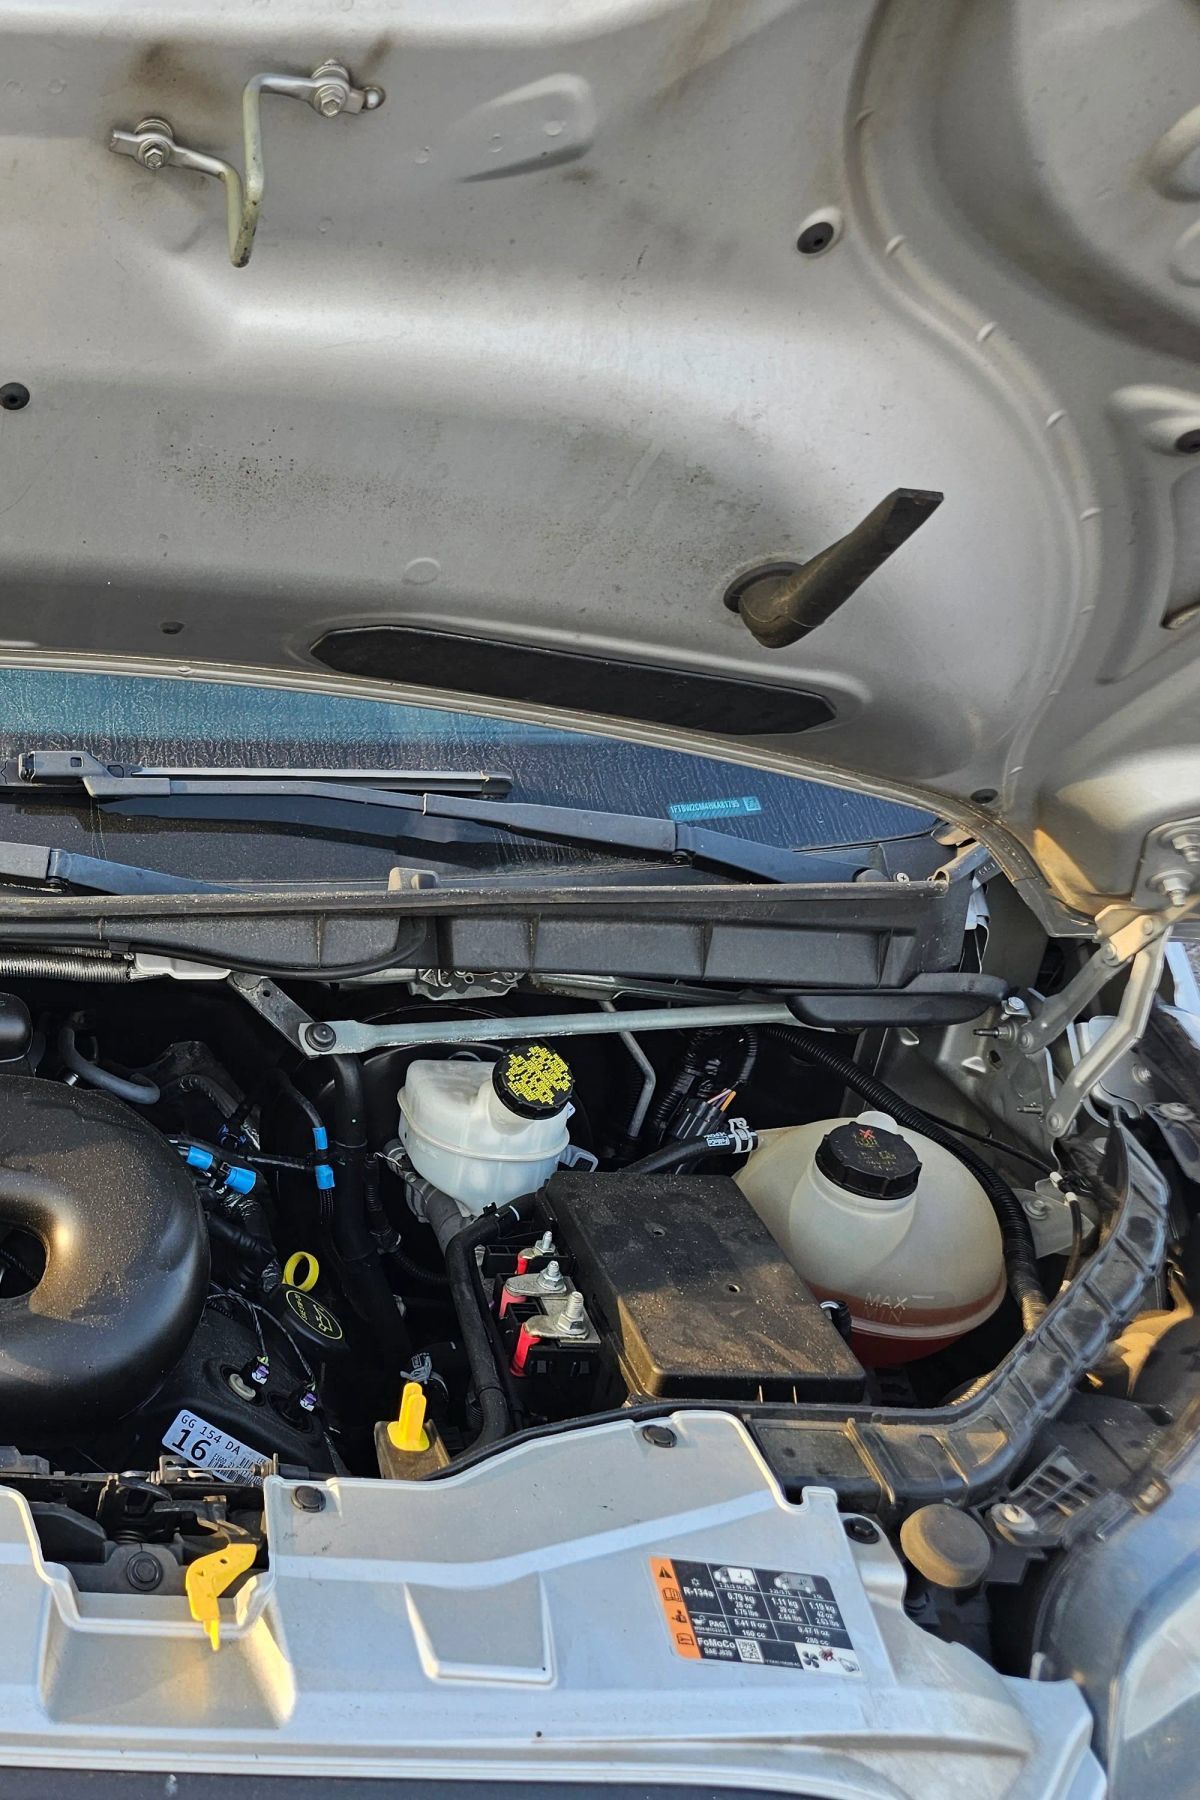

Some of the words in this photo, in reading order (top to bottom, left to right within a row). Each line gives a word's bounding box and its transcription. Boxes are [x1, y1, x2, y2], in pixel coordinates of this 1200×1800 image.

[864, 1291, 908, 1311] MAX
[181, 1414, 198, 1429] GG
[199, 1426, 223, 1444] 154
[224, 1440, 241, 1456] DA
[171, 1428, 212, 1461] 16
[683, 1586, 714, 1598] R-134a
[786, 1598, 798, 1609] kg
[823, 1603, 836, 1614] kg
[709, 1620, 726, 1629] PAG
[697, 1637, 736, 1649] FoMoCo
